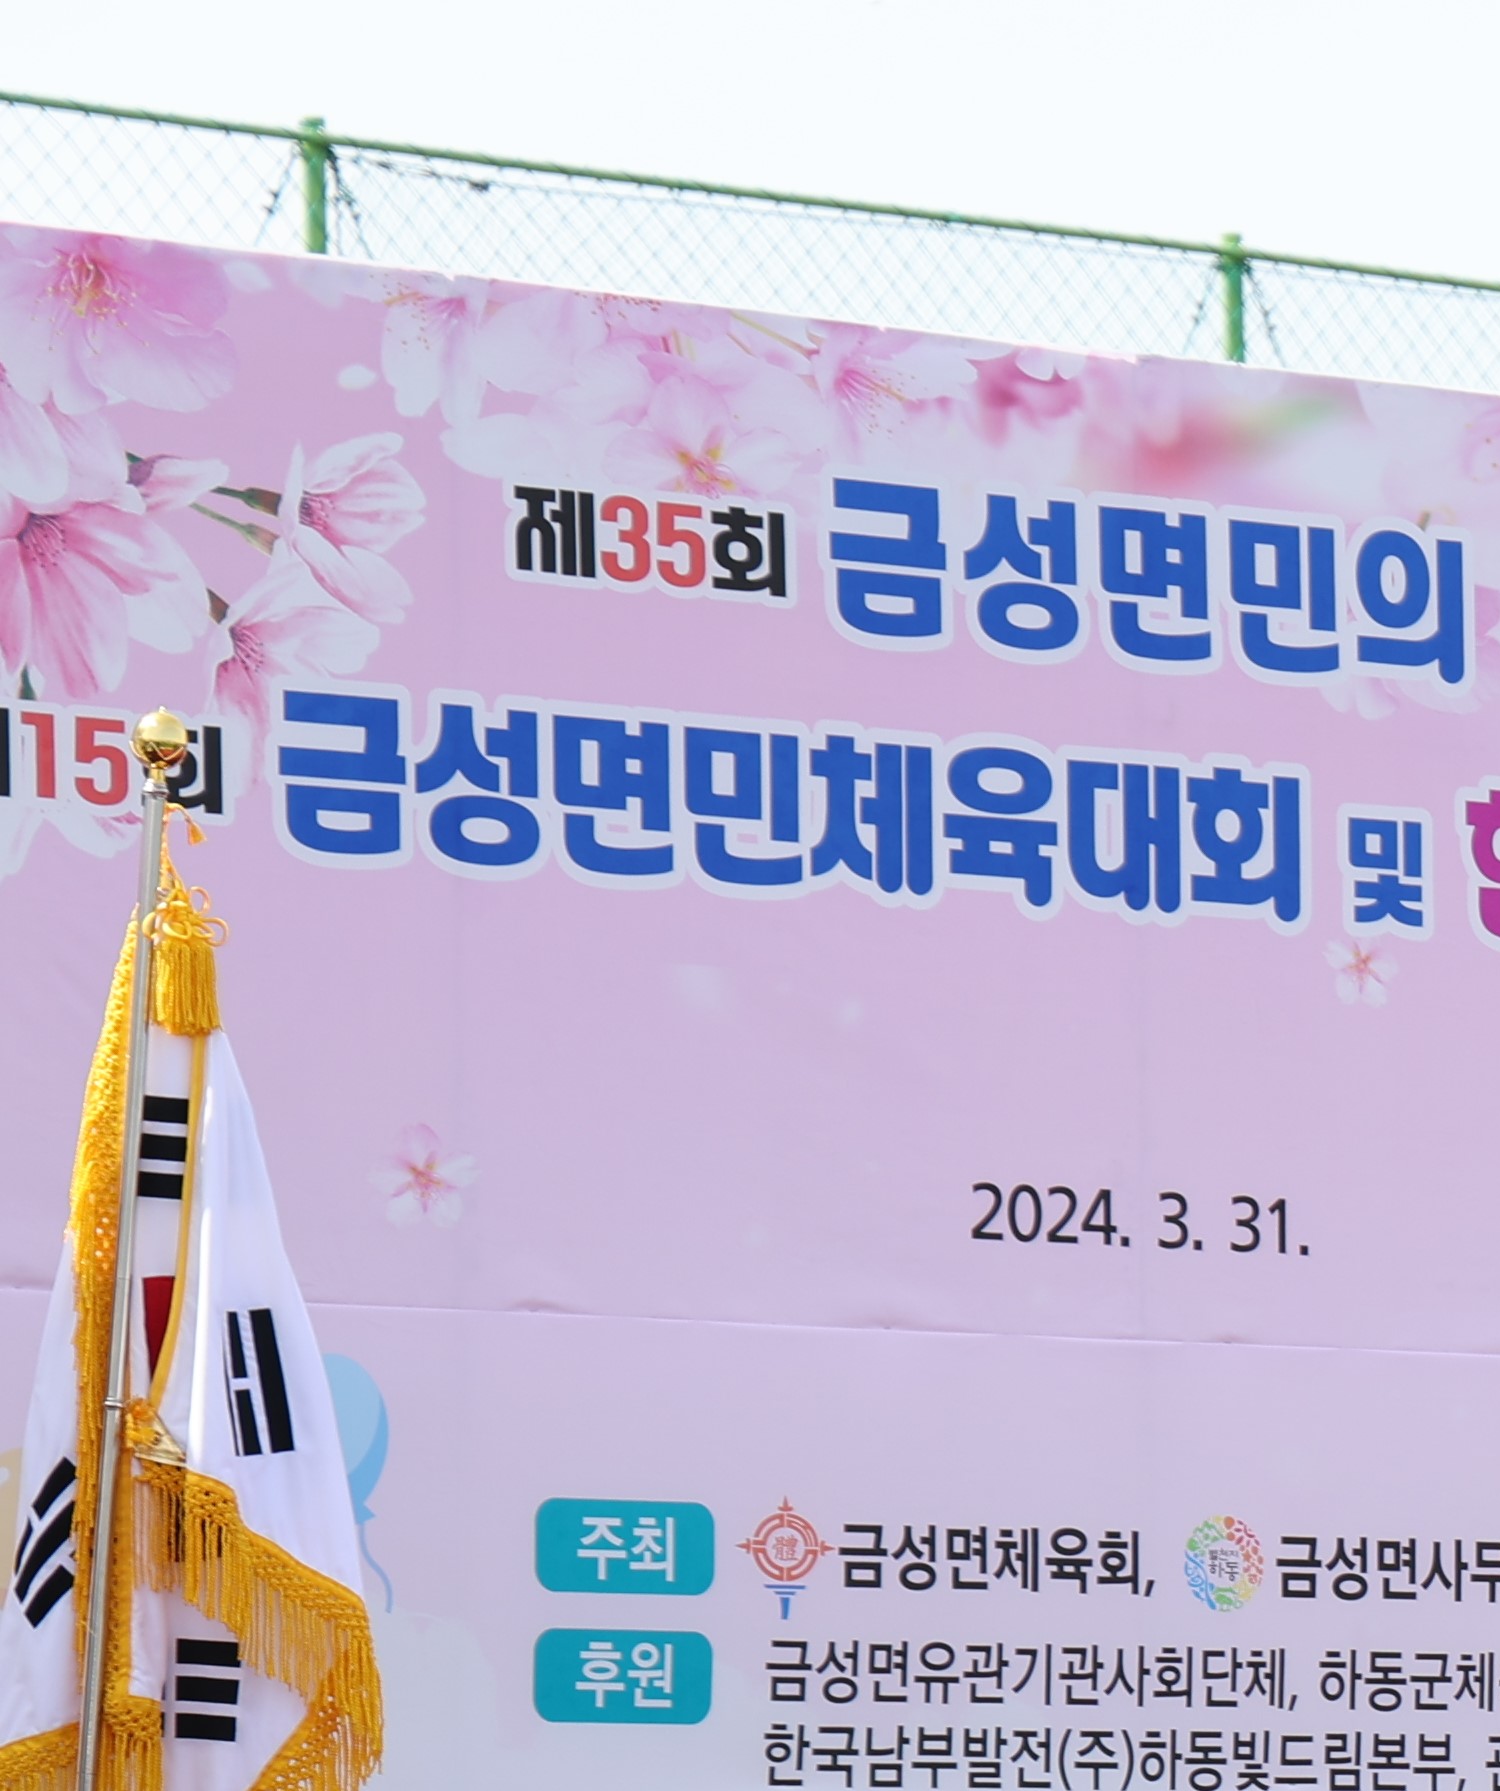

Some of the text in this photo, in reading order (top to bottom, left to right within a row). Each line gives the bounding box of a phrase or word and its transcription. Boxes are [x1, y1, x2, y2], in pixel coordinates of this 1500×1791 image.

[513, 484, 786, 598] 제35회
[827, 476, 1464, 685] 금성면민의
[0, 706, 224, 815] 15회
[278, 690, 1302, 923] 금성면민체육대회
[1346, 815, 1425, 930] 및
[971, 1181, 1310, 1256] 2024. 3. 31.
[576, 1516, 678, 1582] 주최
[837, 1521, 1156, 1596] 금성면체육회,
[574, 1643, 676, 1709] 후원
[763, 1639, 1300, 1714] 금성면유관기관사회단체,
